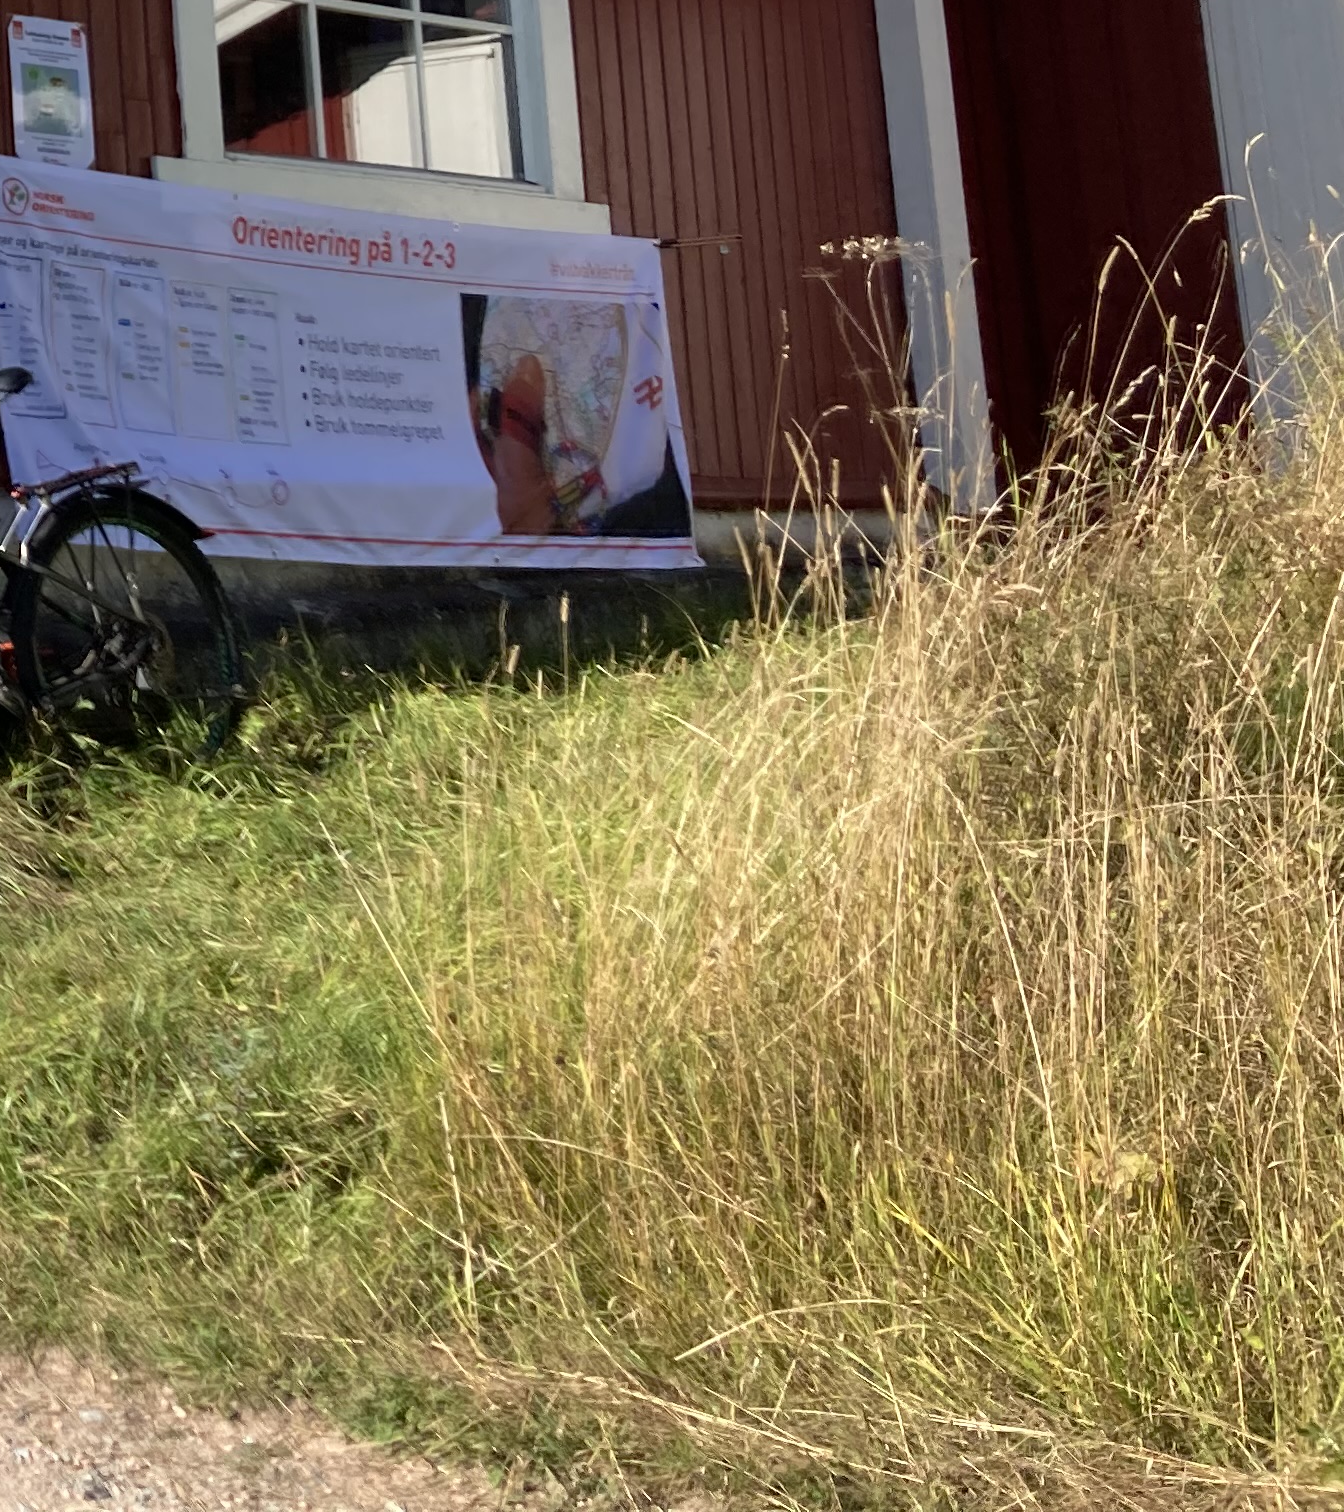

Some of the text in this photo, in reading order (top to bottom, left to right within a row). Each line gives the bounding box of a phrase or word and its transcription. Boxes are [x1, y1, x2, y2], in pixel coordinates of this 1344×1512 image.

[232, 216, 456, 269] Orientering på 1-2-3
[312, 387, 346, 408] Bruk
[314, 414, 349, 434] Bruk
